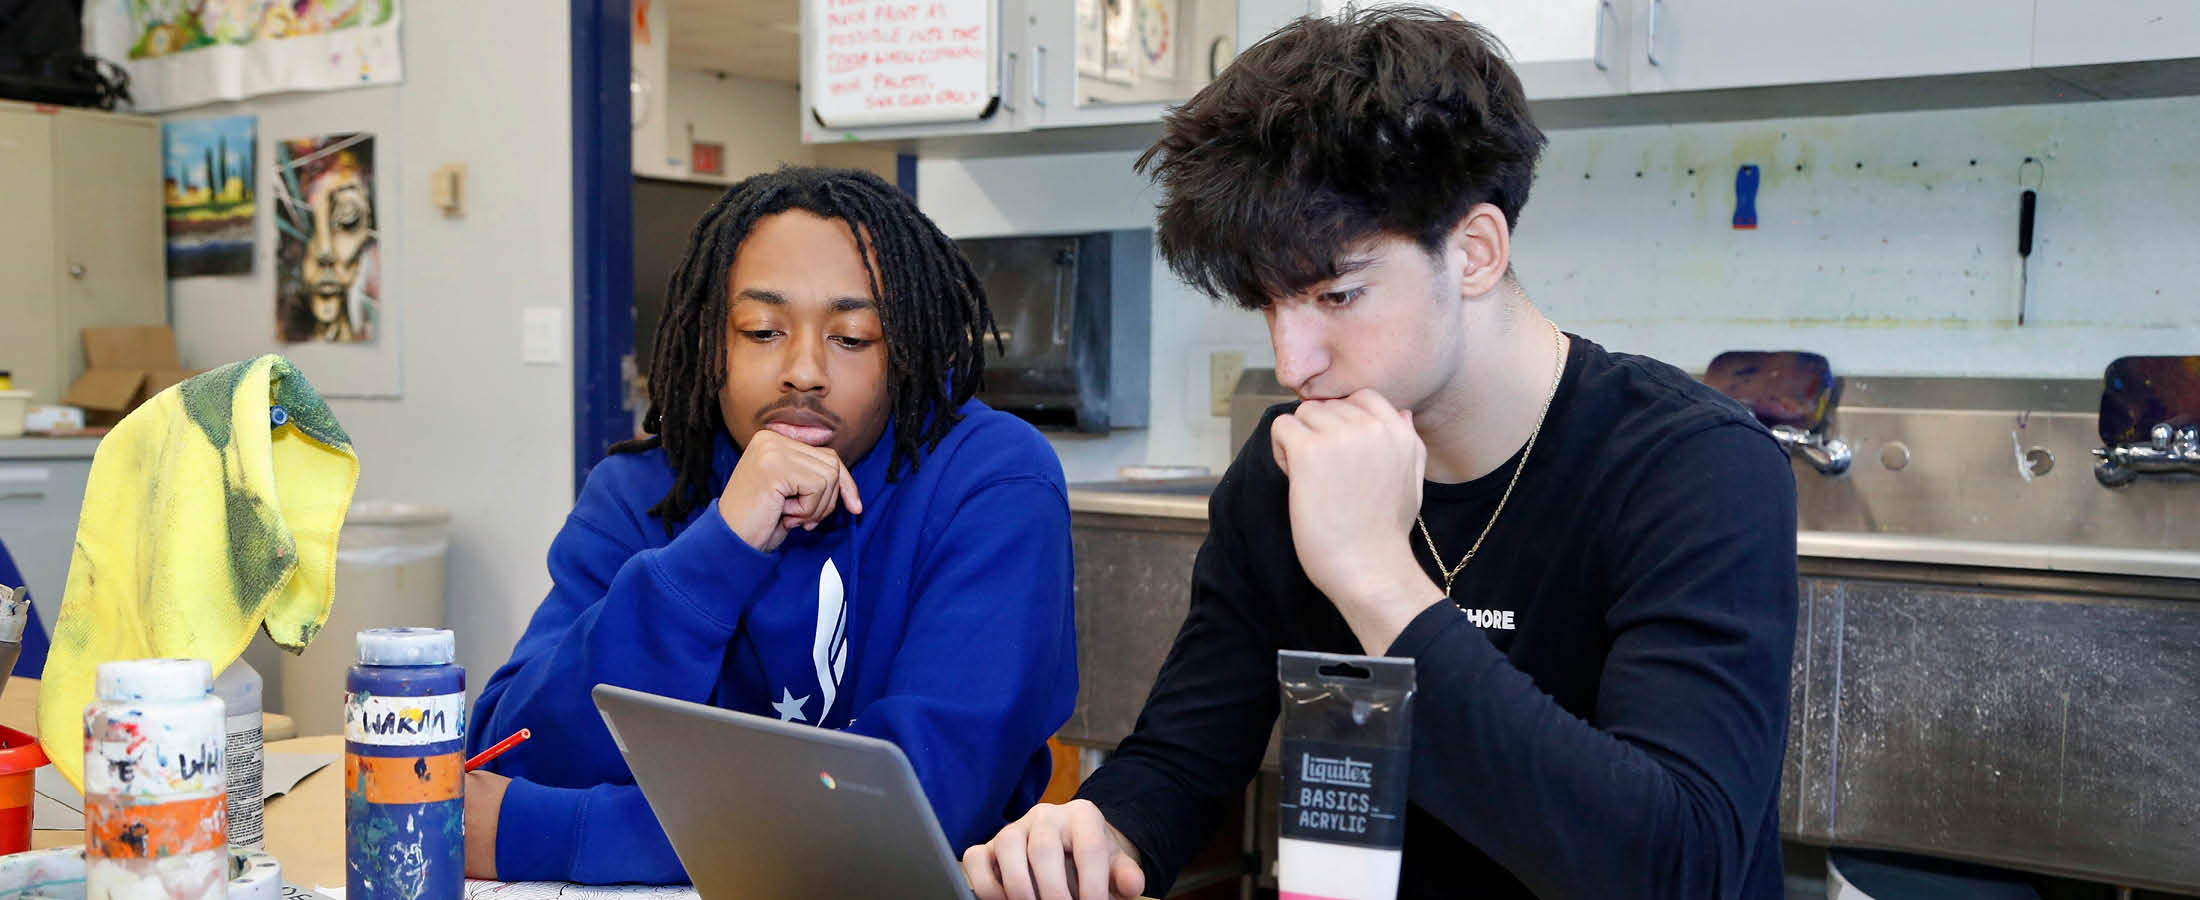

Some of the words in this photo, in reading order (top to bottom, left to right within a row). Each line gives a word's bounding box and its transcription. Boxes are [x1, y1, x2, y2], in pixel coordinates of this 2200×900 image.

[1302, 752, 1372, 786] Liquitex
[1300, 787, 1369, 813] BASICS
[1299, 809, 1367, 834] ACRYLIC
